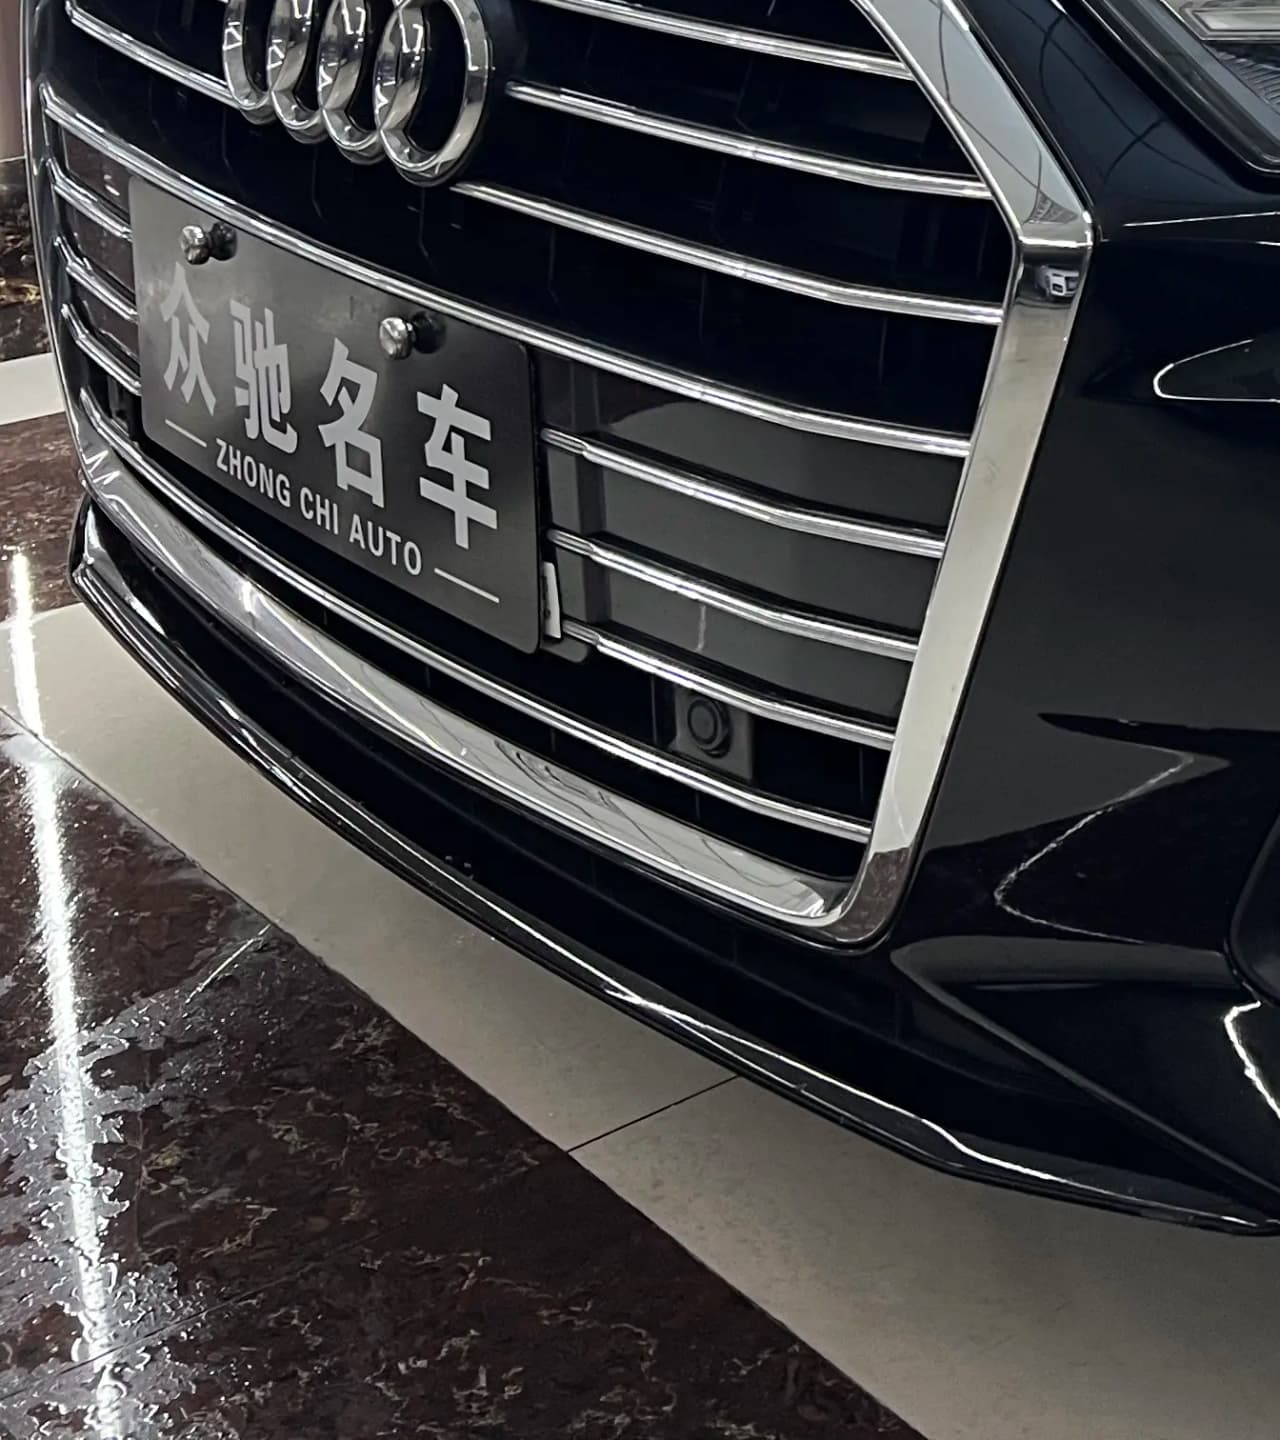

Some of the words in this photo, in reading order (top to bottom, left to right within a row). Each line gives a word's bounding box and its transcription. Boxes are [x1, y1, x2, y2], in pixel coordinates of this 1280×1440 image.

[160, 261, 499, 551] 众驰名车
[214, 437, 292, 509] ZHONG
[299, 486, 340, 536] CHI
[348, 513, 423, 577] AUTO
